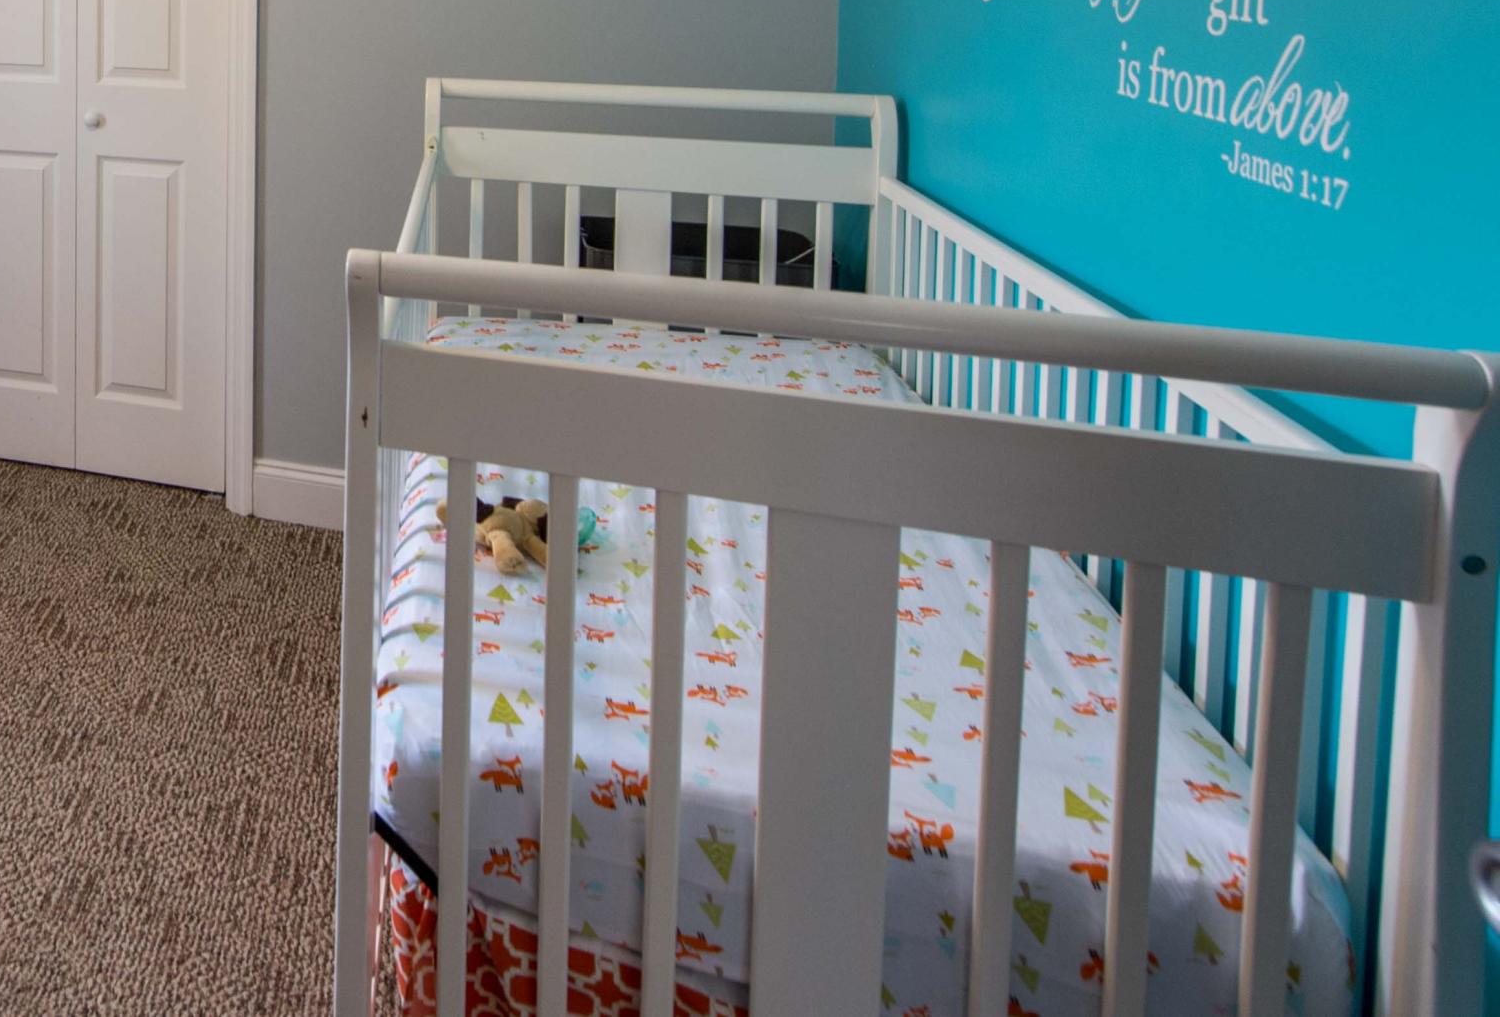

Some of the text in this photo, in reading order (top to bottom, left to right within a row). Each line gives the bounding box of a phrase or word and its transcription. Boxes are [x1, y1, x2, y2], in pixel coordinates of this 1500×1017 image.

[1116, 41, 1141, 100] is
[1147, 46, 1227, 124] from
[1220, 140, 1350, 210] -James 1:17
